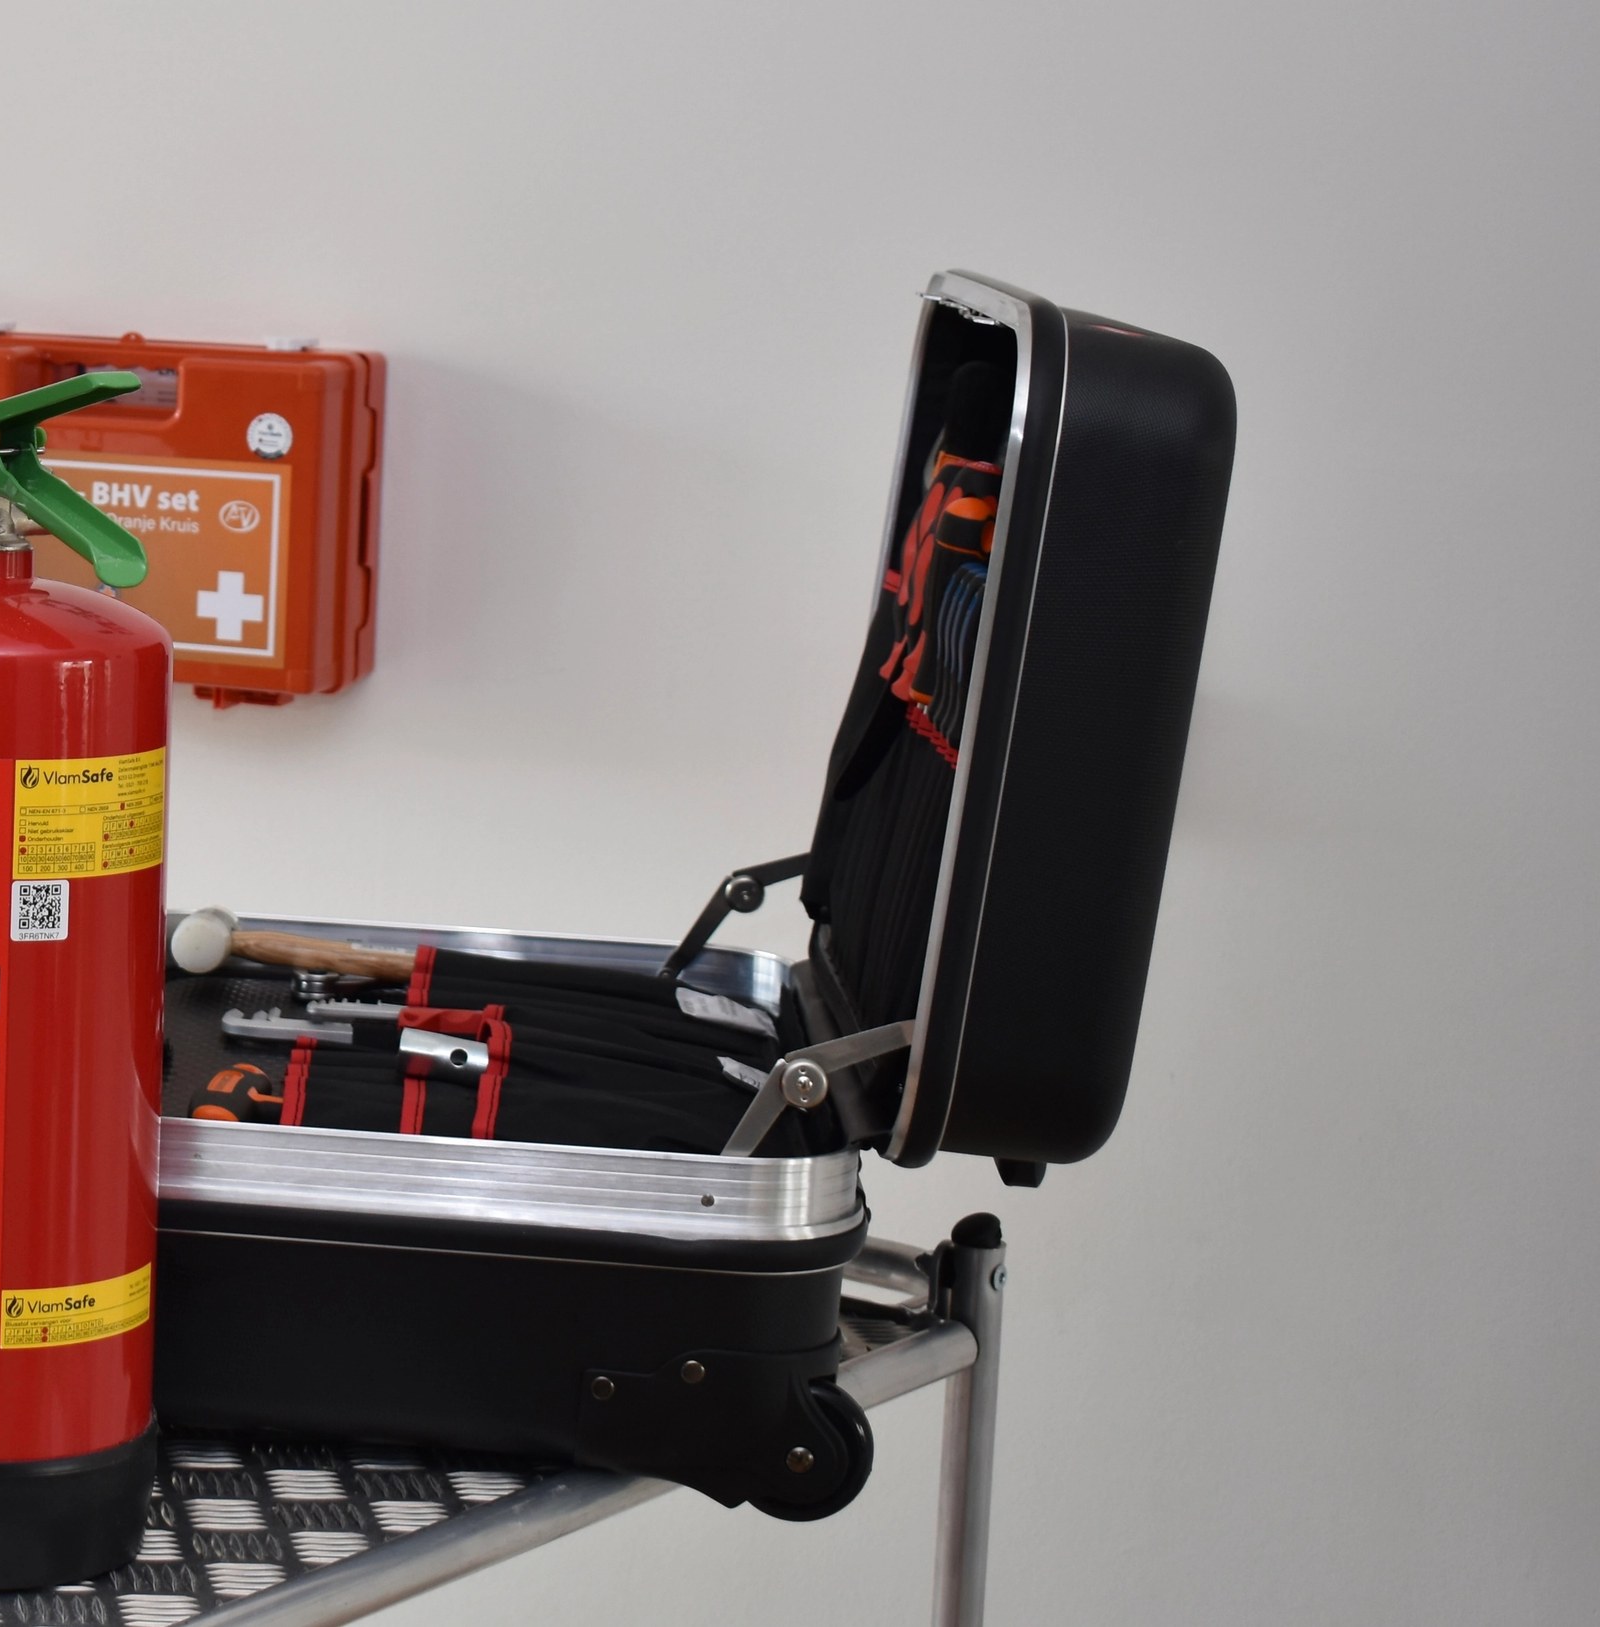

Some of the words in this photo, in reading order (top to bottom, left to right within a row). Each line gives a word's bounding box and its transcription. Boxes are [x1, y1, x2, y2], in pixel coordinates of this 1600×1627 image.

[91, 480, 152, 508] BHV
[157, 489, 200, 512] set
[159, 514, 201, 535] Kruis
[43, 767, 114, 785] VlamSafe
[27, 1294, 96, 1314] VlamSafe
